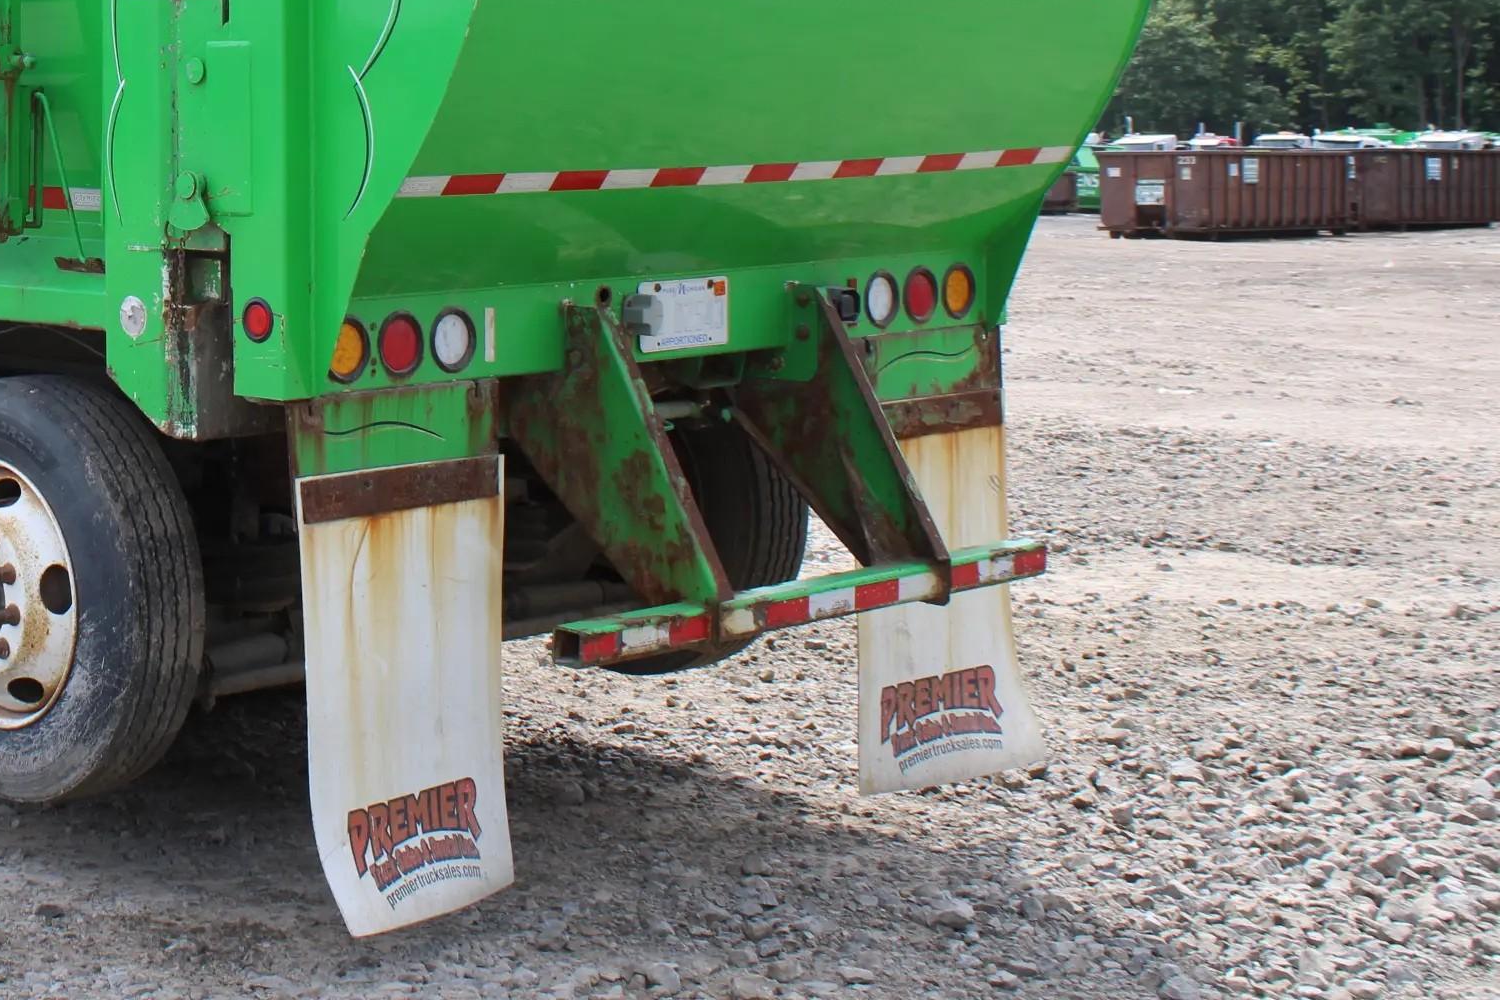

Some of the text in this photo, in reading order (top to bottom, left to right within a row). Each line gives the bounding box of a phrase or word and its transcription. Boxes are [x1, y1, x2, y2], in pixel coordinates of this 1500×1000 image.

[881, 664, 1004, 745] PREMIER
[898, 737, 1004, 776] premiertrucksales.com
[347, 776, 482, 880] PREMIER
[386, 863, 482, 911] premiertrucksales.com
